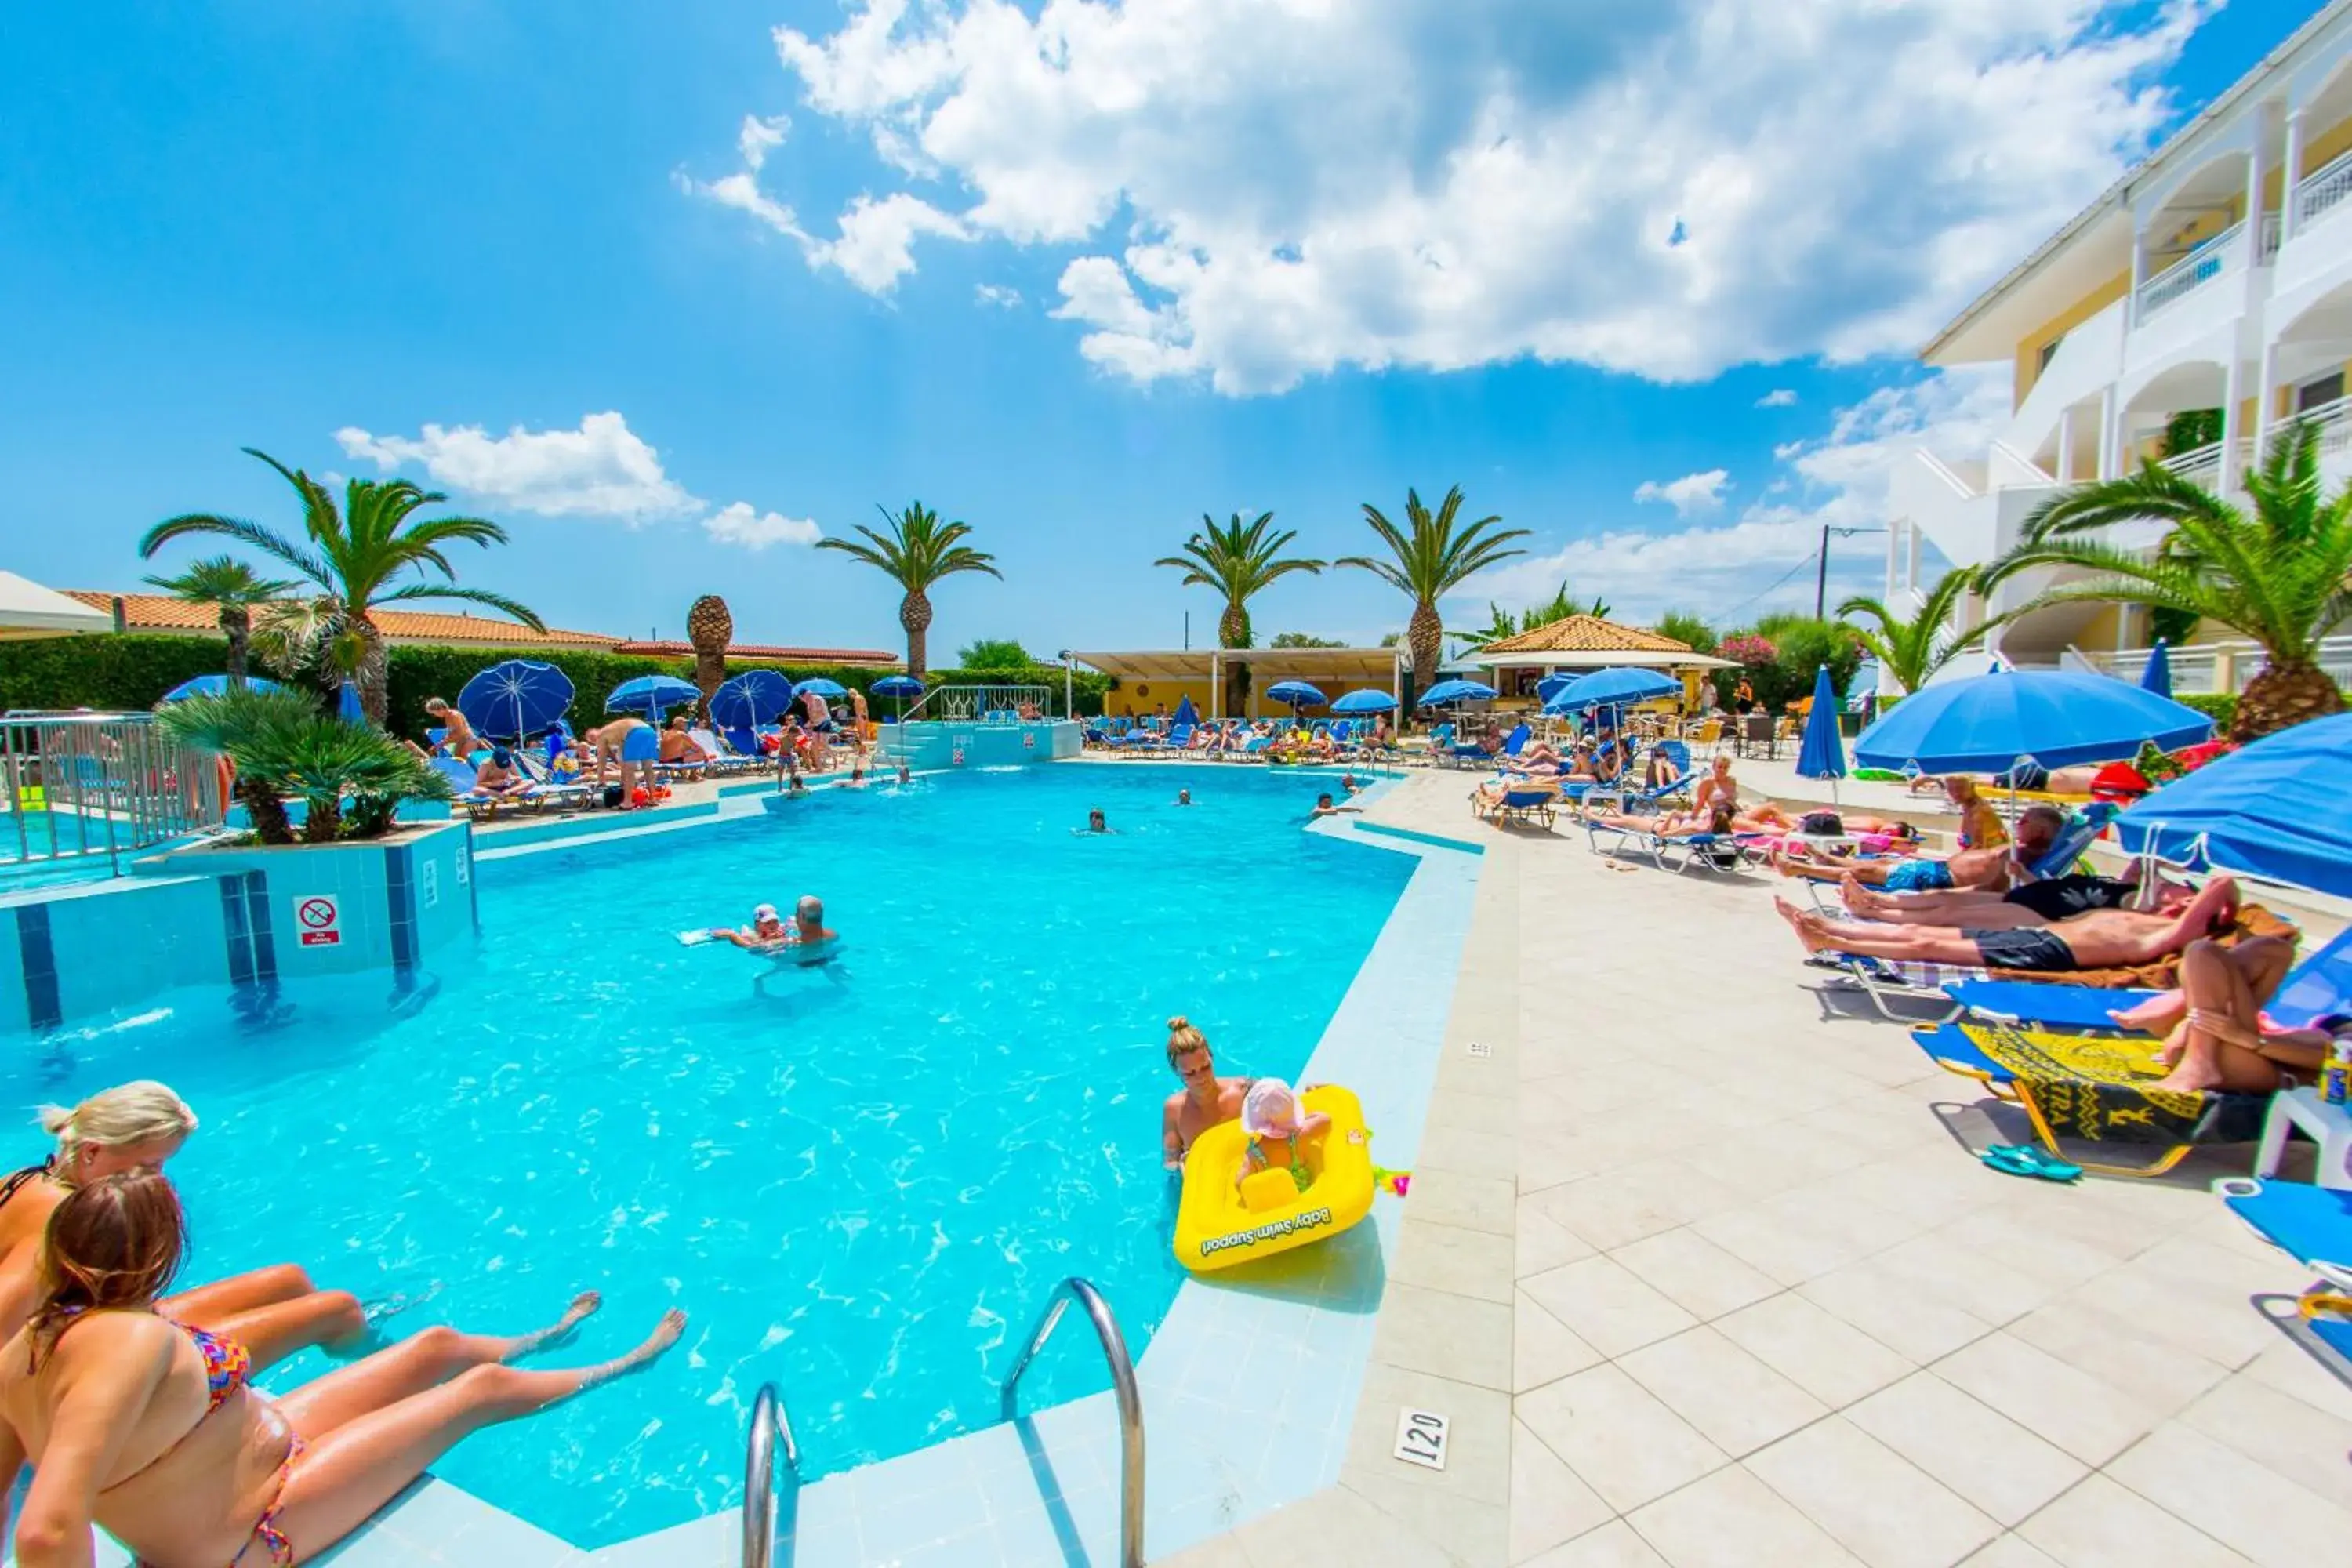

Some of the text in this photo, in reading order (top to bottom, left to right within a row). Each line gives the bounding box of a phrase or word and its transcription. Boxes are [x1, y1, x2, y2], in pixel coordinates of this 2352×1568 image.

[1294, 1207, 1331, 1229] Baby
[1255, 1219, 1293, 1240] Swim
[1402, 1414, 1443, 1461] 120
